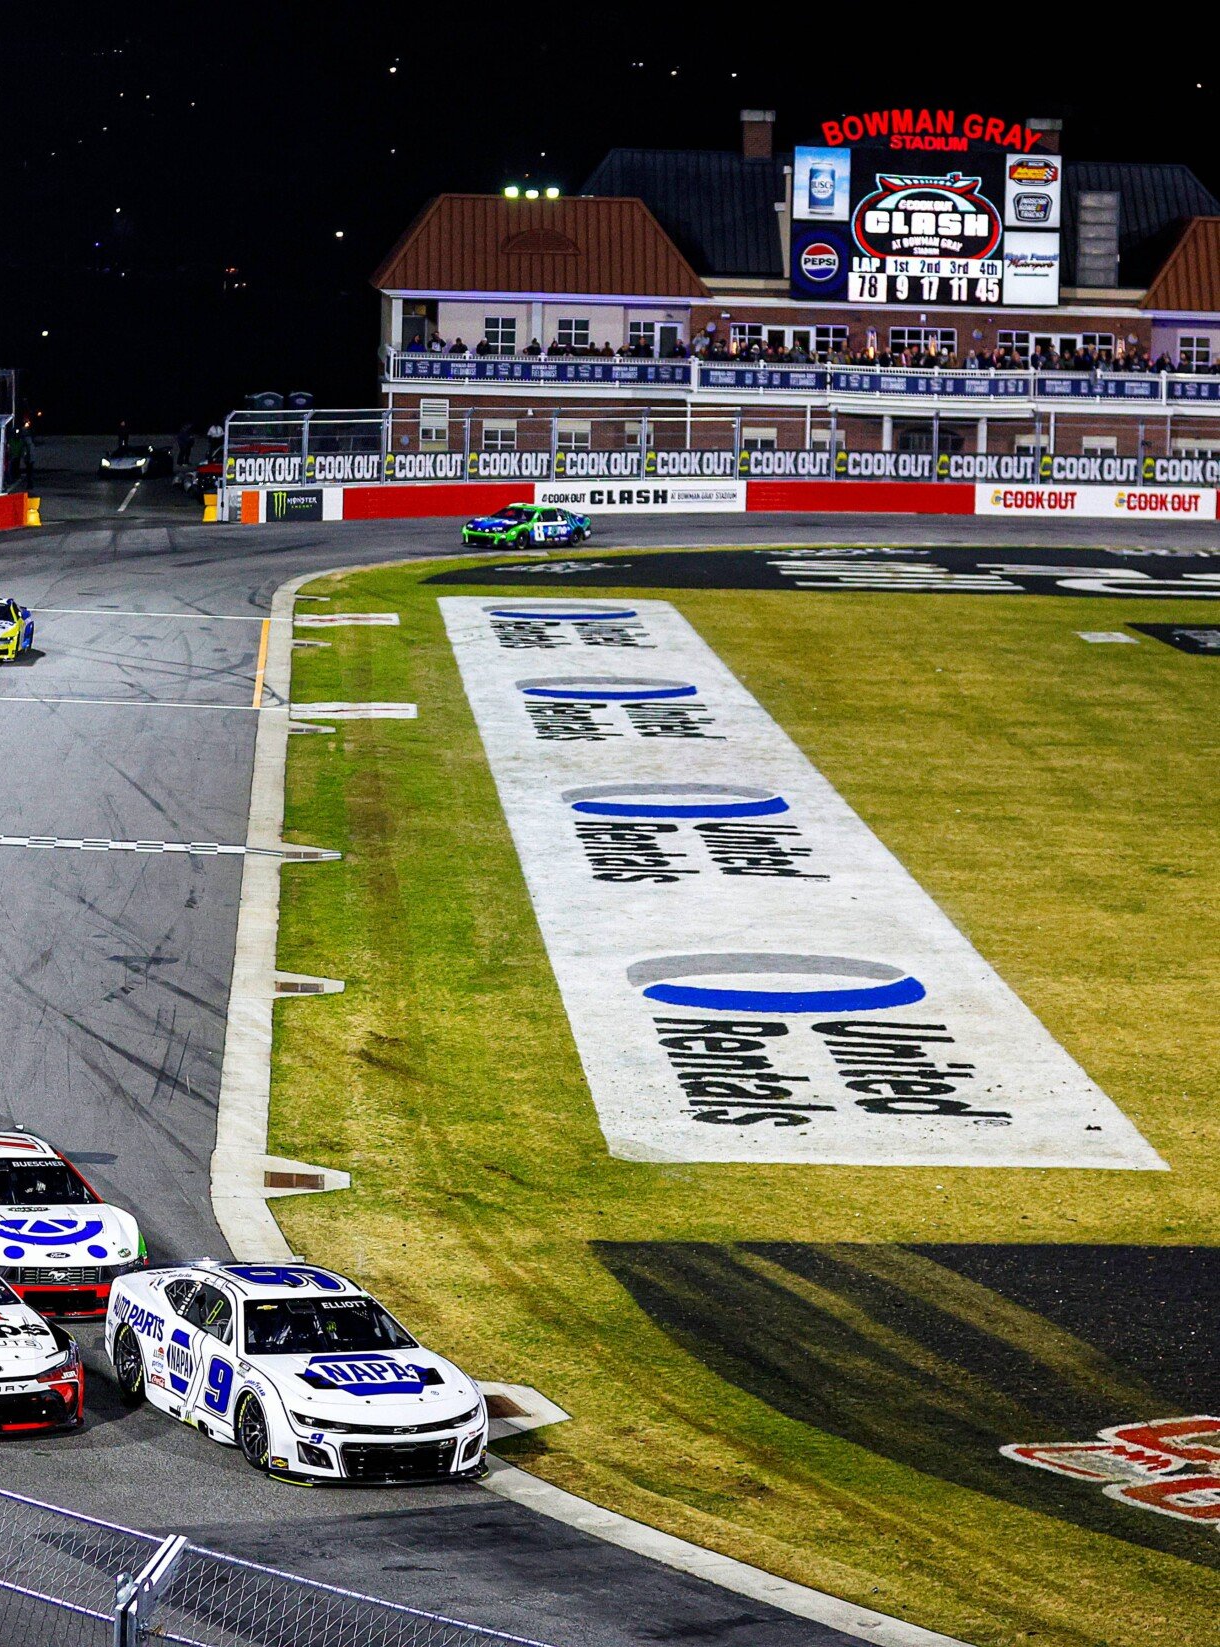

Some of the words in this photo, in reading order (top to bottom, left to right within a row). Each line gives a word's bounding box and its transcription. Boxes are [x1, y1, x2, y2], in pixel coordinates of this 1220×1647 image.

[822, 109, 955, 147] BOWMAN
[964, 113, 1042, 152] GRAY
[890, 135, 967, 151] STADIUM
[865, 211, 989, 236] CLASH
[892, 239, 901, 250] AT
[902, 236, 940, 248] BOWMAN
[940, 238, 963, 252] GRAY
[804, 257, 836, 266] PEPSI
[853, 257, 880, 273] LAP
[894, 260, 909, 274] 1st
[920, 259, 941, 274] 2nd
[949, 259, 969, 274] 3rd
[979, 259, 998, 275] 4th
[858, 276, 878, 299] 78
[896, 276, 909, 300] 9
[921, 277, 939, 300] 17
[949, 277, 968, 300] 11
[975, 277, 999, 302] 45
[235, 457, 276, 482] COOK
[276, 457, 301, 482] OUT
[315, 455, 353, 479] COOK
[354, 455, 380, 479] OUT
[395, 454, 438, 478] COOK
[438, 454, 463, 478] OUT
[479, 452, 522, 476] COOK
[524, 452, 550, 476] OUT
[566, 452, 608, 476] COOK
[611, 452, 641, 476] OUT
[657, 451, 701, 475] COOK
[703, 451, 733, 475] OUT
[750, 451, 796, 475] COOK
[798, 451, 829, 475] OUT
[848, 453, 896, 477] COOK
[899, 453, 932, 477] OUT
[950, 454, 997, 479] COOK
[1000, 454, 1034, 479] OUT
[1052, 456, 1104, 481] COOK
[1107, 456, 1137, 481] OUT
[1156, 458, 1203, 483] COOK
[287, 496, 317, 505] MONSTER
[549, 494, 570, 504] COOK
[571, 493, 586, 503] OUT
[590, 489, 668, 505] CLASH
[678, 492, 700, 501] BOWMAN
[701, 492, 715, 501] GRAY
[716, 491, 737, 500] STADIUM
[1003, 490, 1044, 509] COOK
[1047, 492, 1076, 510] OUT
[1127, 492, 1168, 511] COOK
[1171, 494, 1201, 512] OUT
[534, 523, 545, 541] 8
[524, 701, 624, 741] Rentals
[621, 702, 727, 741] United
[574, 821, 700, 883] Rentals
[692, 823, 830, 879] United
[654, 1017, 837, 1128] Rentals
[811, 1021, 1012, 1118] United
[321, 1300, 368, 1309] ELLIOTT
[112, 1292, 130, 1323] AUTO
[129, 1304, 165, 1342] PARTS
[169, 1344, 192, 1379] NAPA
[319, 1362, 415, 1383] NAPA
[61, 1370, 78, 1380] JGR
[204, 1356, 234, 1415] 9
[244, 1380, 266, 1397] GOODYEAR
[308, 1433, 324, 1444] 9
